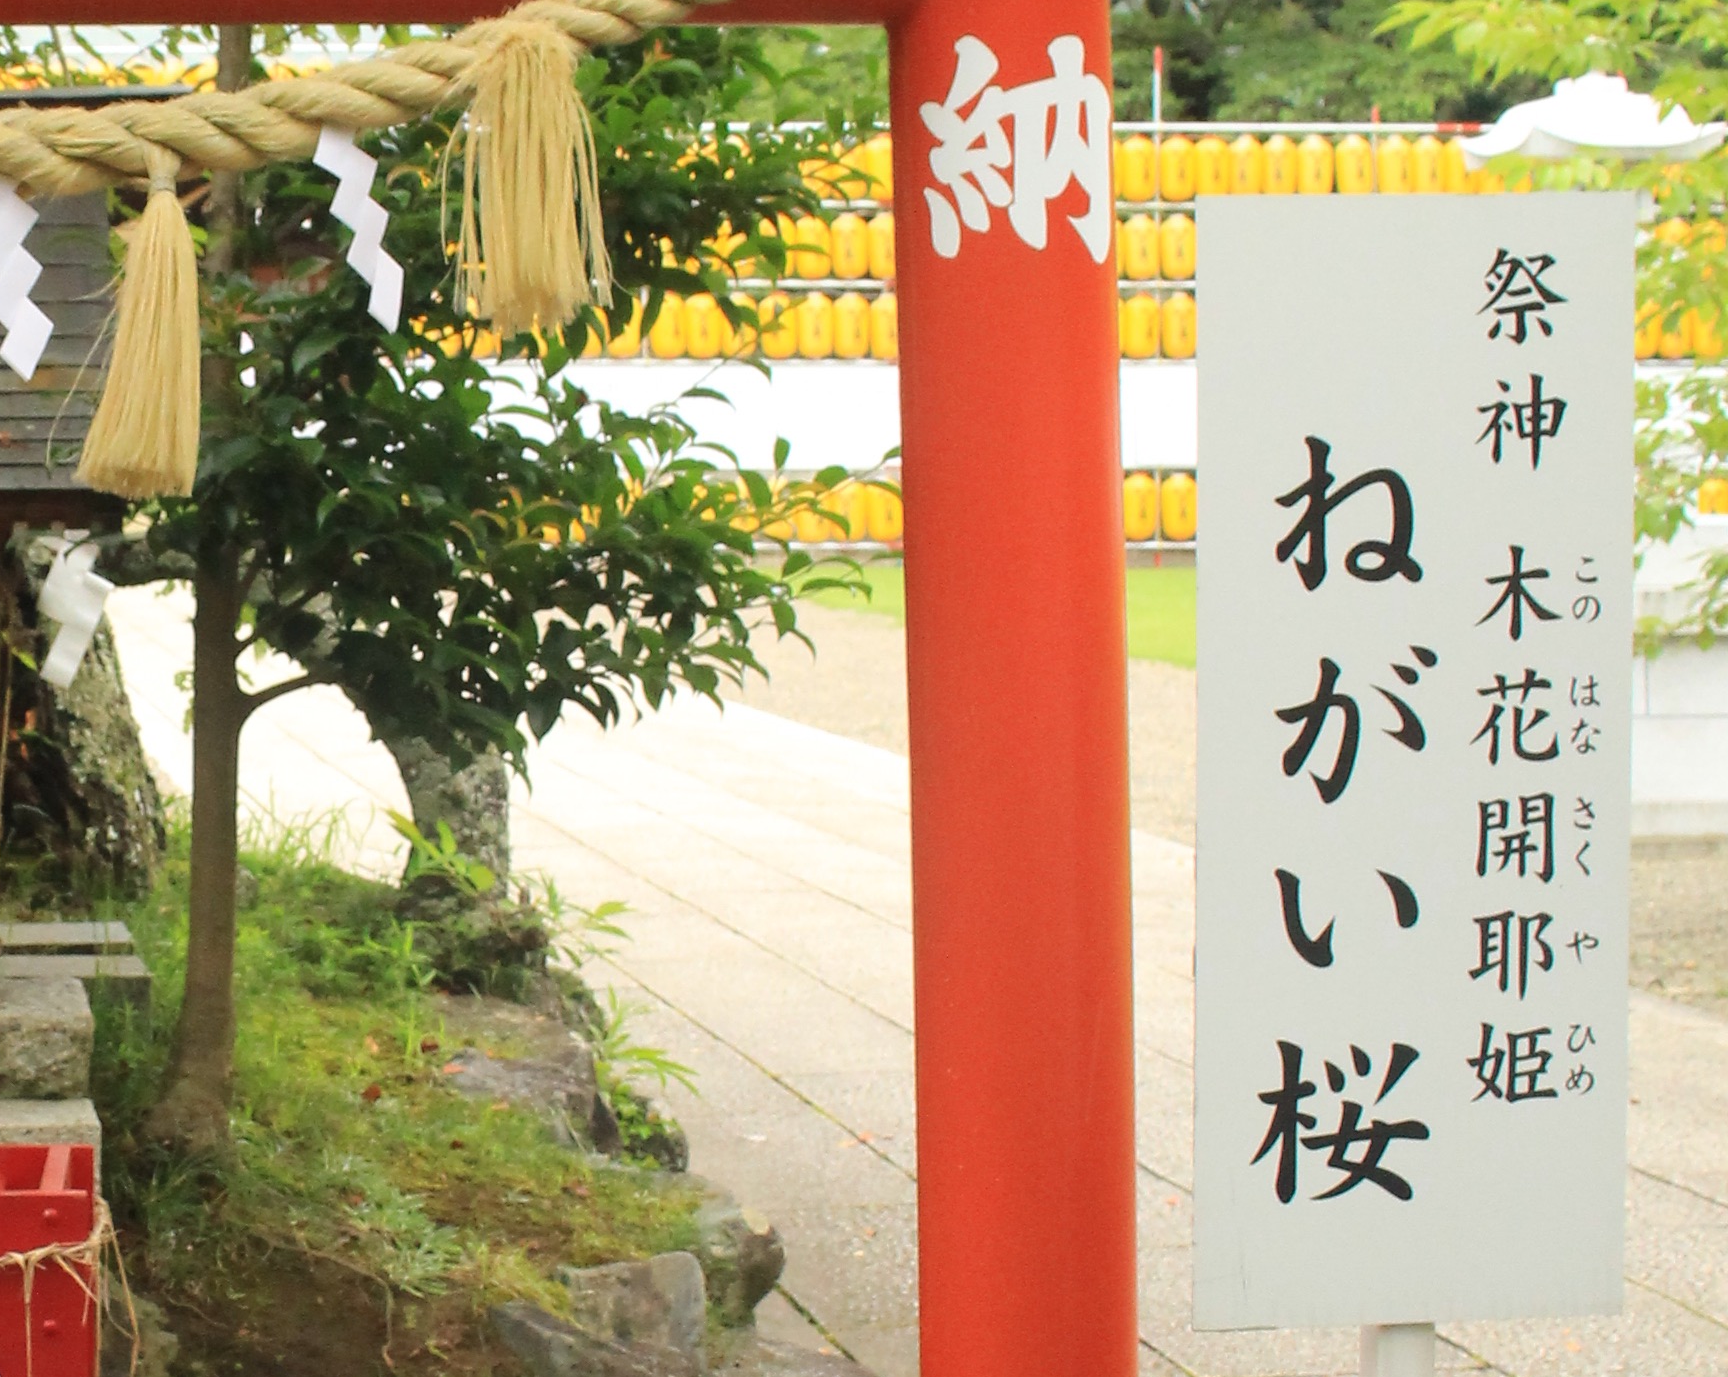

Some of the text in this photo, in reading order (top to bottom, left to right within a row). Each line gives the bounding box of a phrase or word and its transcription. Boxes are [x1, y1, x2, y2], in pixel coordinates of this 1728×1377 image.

[919, 34, 1113, 265] 納
[1249, 435, 1439, 1206] ねがい桜
[1466, 247, 1569, 1105] 祭神 木花開耶姫
[1564, 555, 1603, 1096] この はな さく や ひめ
